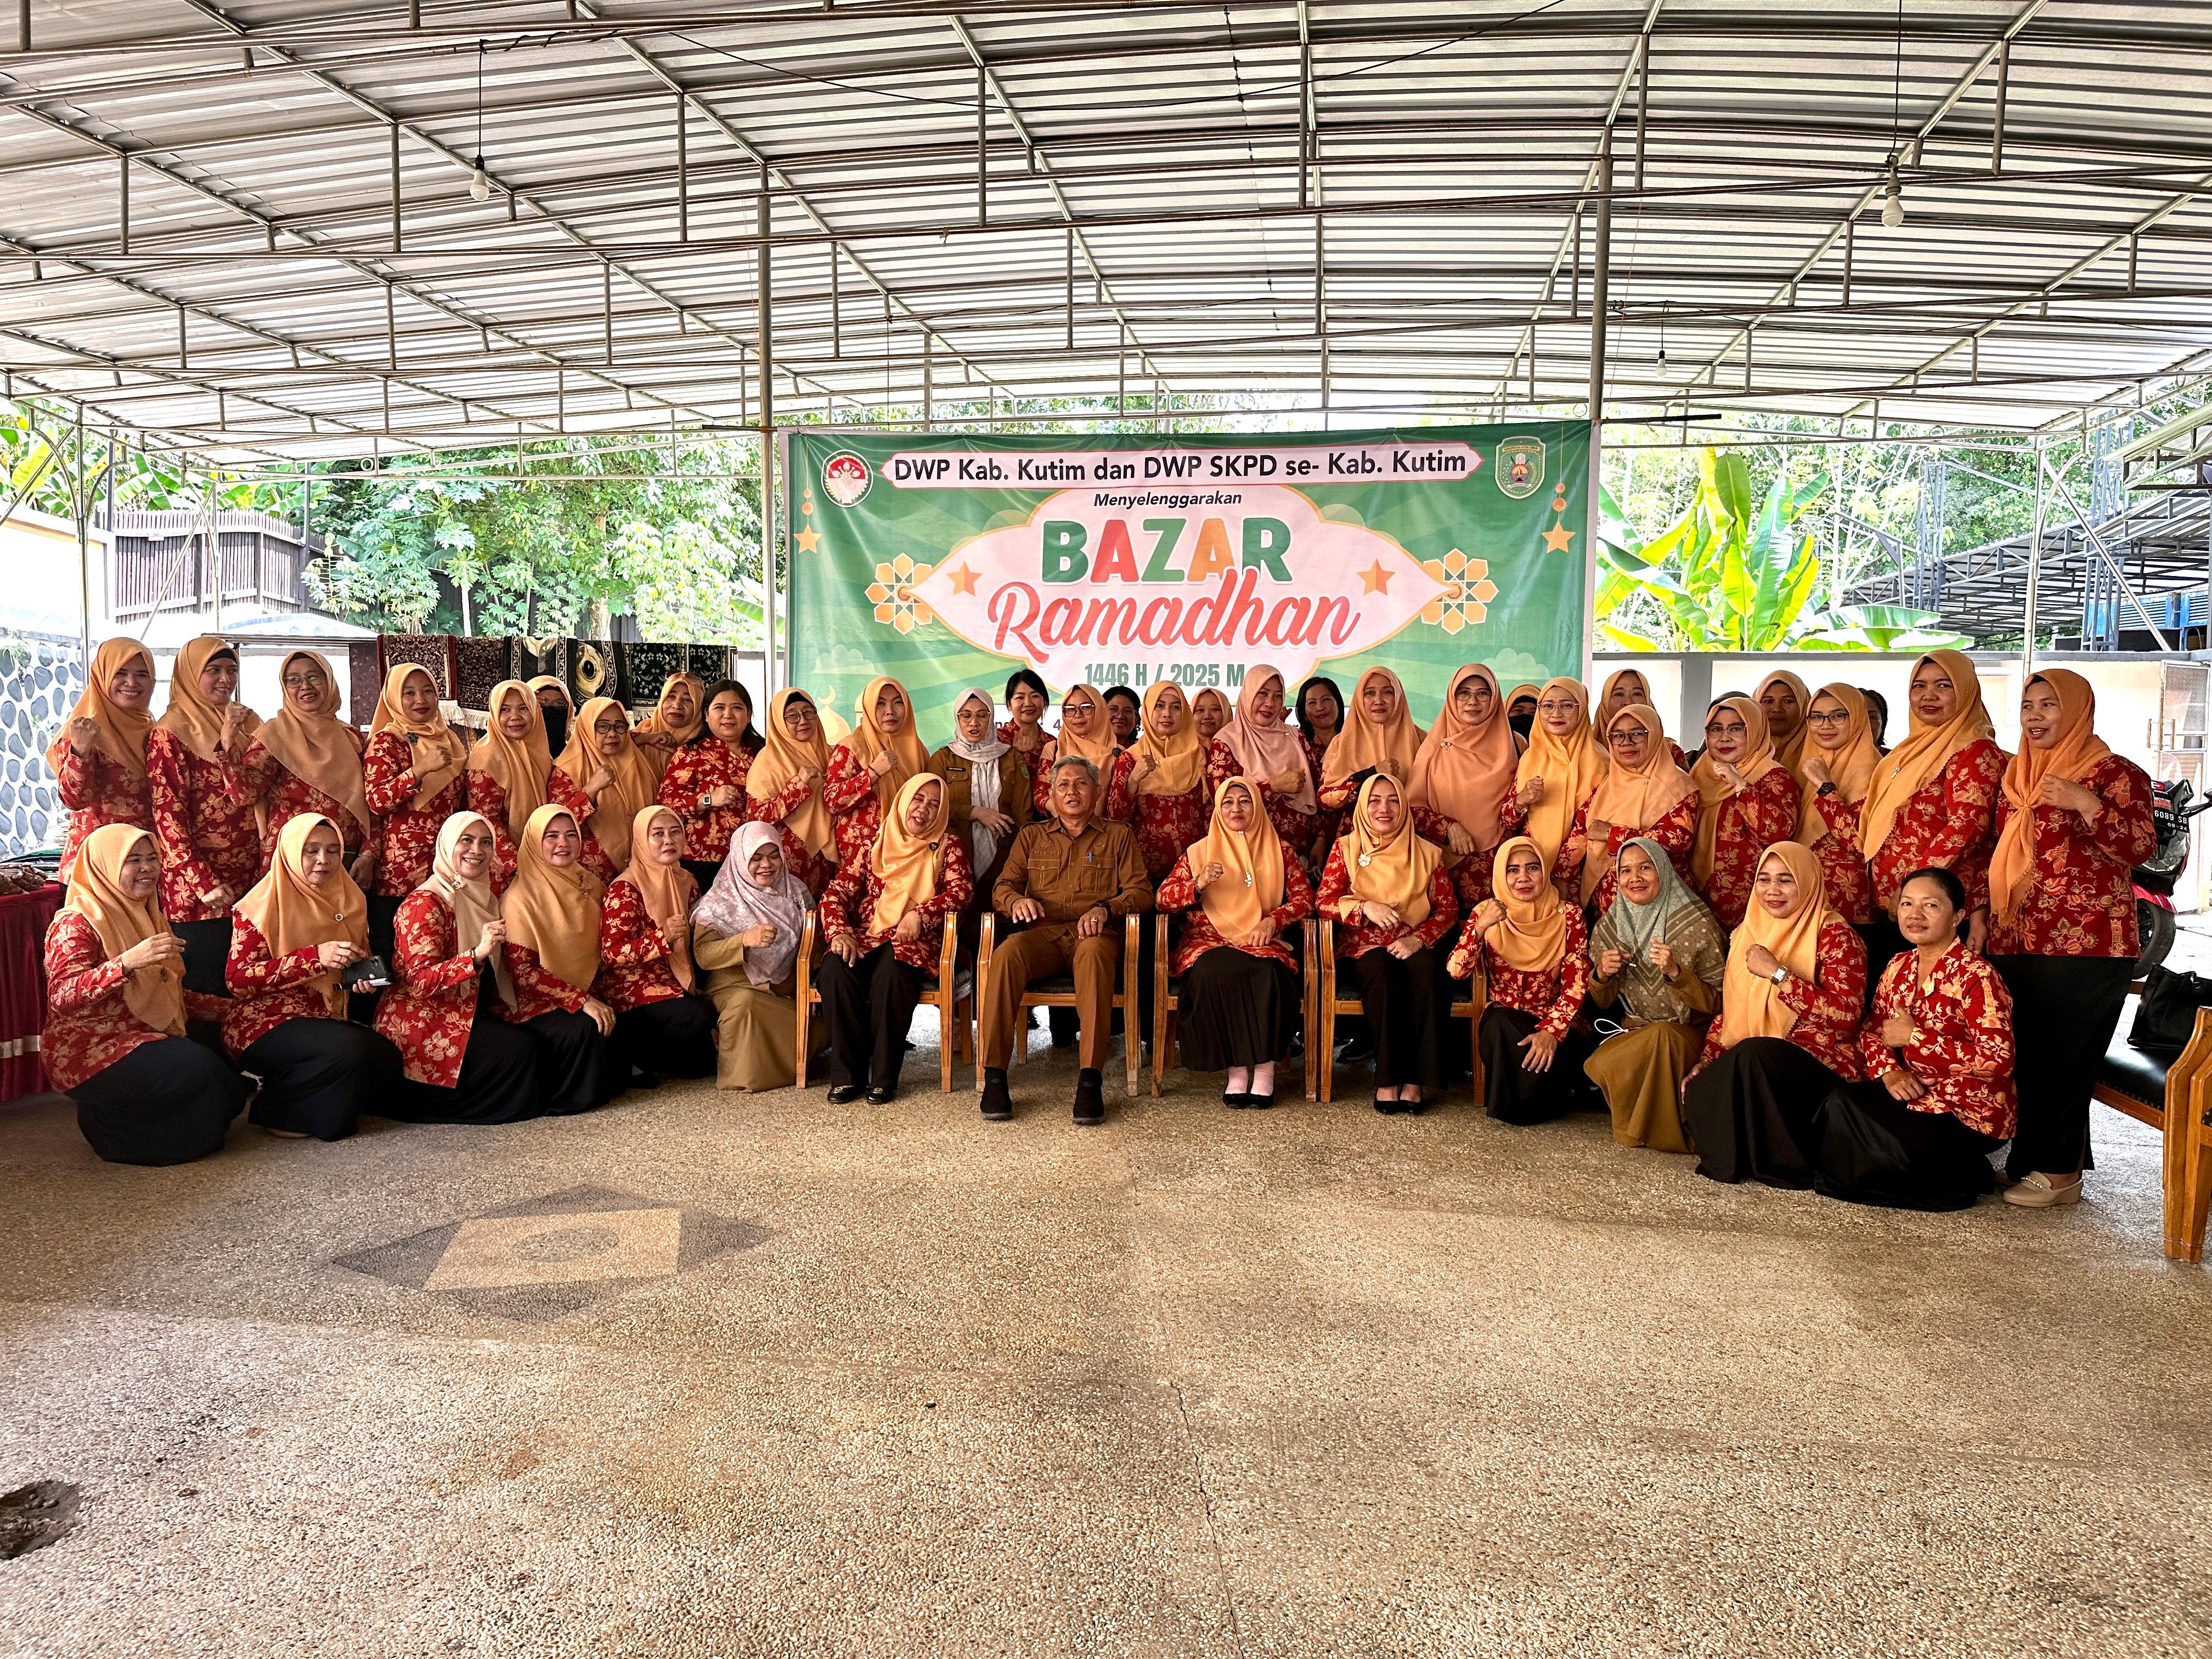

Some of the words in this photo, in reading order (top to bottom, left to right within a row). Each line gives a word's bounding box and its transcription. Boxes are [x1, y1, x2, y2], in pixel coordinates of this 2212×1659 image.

[895, 459, 950, 480] DWP
[959, 458, 1008, 481] Kab.
[1018, 458, 1085, 481] Kutim
[1094, 457, 1135, 480] dan
[1144, 455, 1202, 478] DWP
[1209, 455, 1277, 477] SKPD
[1285, 460, 1319, 476] se-
[1328, 450, 1383, 475] Kab.
[1393, 449, 1465, 473] Kutim
[1094, 490, 1242, 510] Menyelenggarakan
[1042, 517, 1293, 583] BAZAR
[988, 567, 1361, 664] Ramadhan
[1085, 663, 1129, 686] 1446
[1135, 663, 1147, 686] H
[1154, 663, 1164, 683] /
[1169, 663, 1220, 686] 2025
[1226, 664, 1245, 687] M
[2154, 810, 2174, 820] 6089
